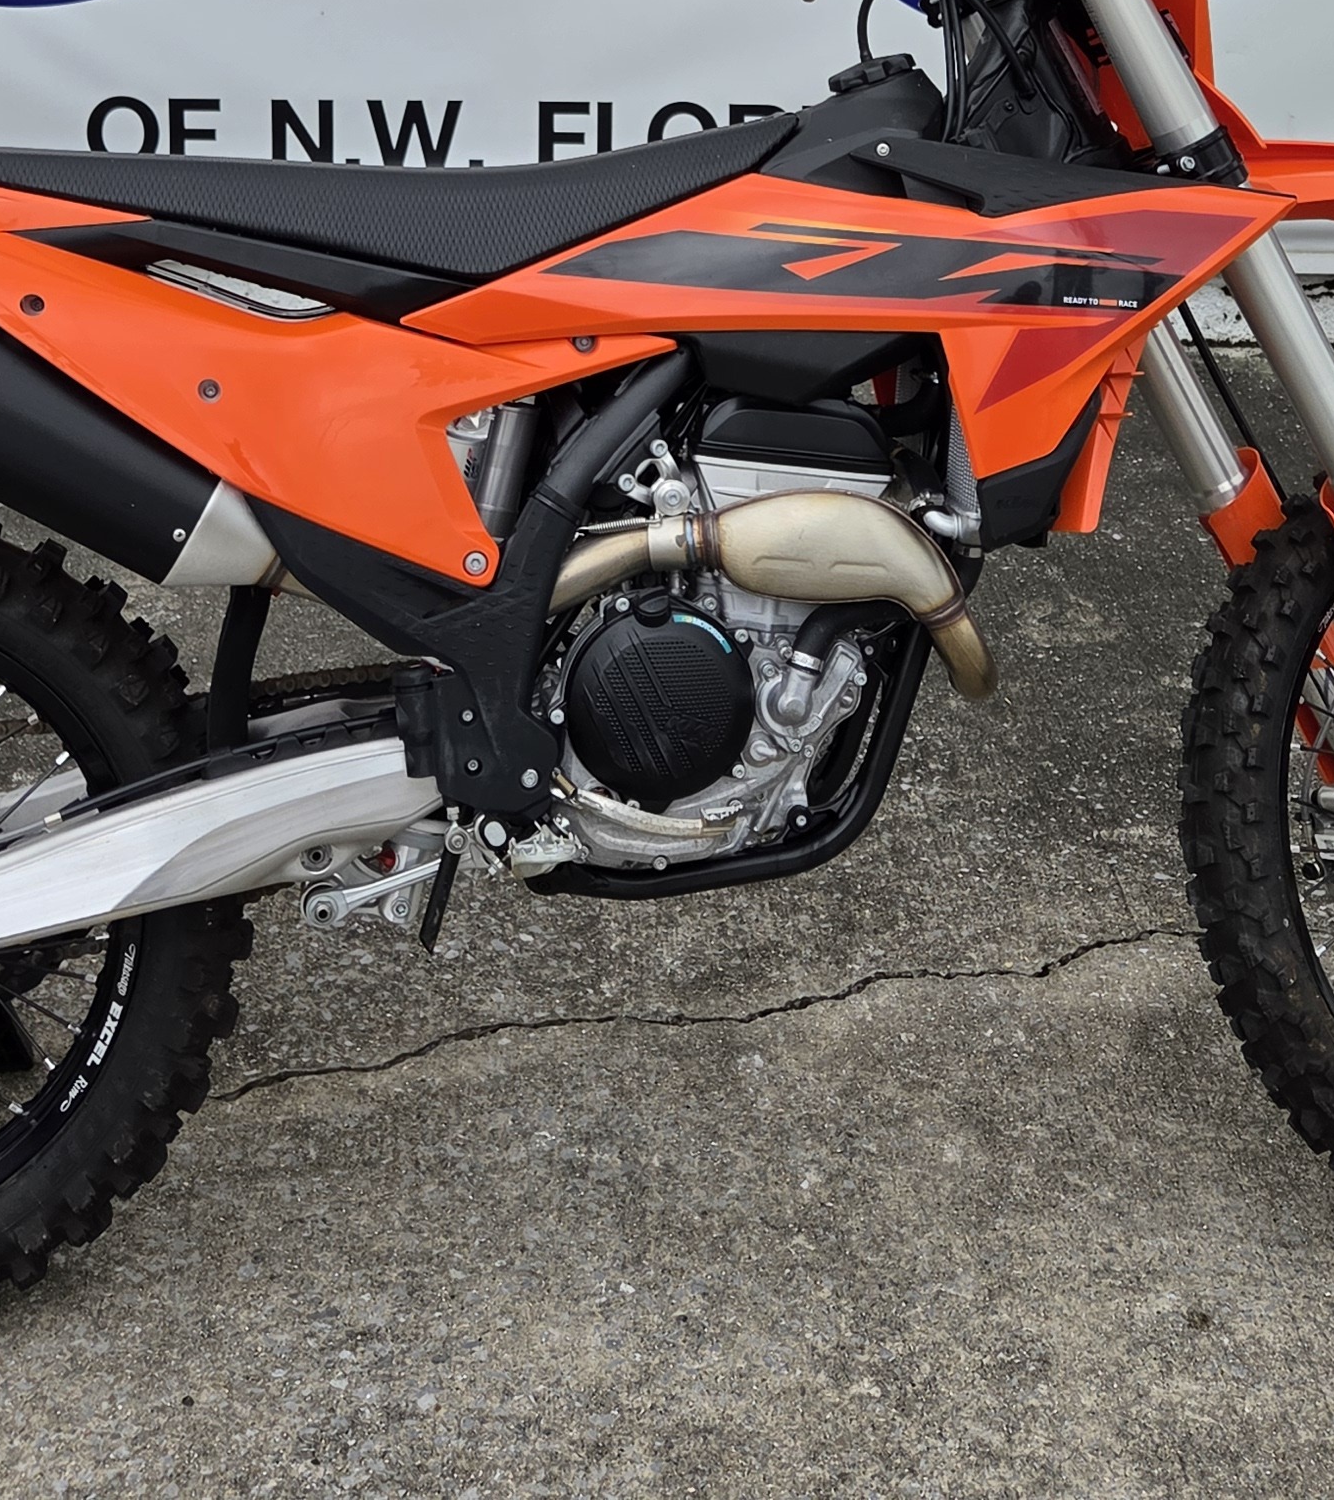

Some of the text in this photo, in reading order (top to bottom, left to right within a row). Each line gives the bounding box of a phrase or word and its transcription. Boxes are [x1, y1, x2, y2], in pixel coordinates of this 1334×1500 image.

[87, 96, 220, 155] OF
[1063, 296, 1138, 308] READY TO RACE
[86, 1001, 124, 1067] EXCEL
[60, 1074, 88, 1112] Rim
